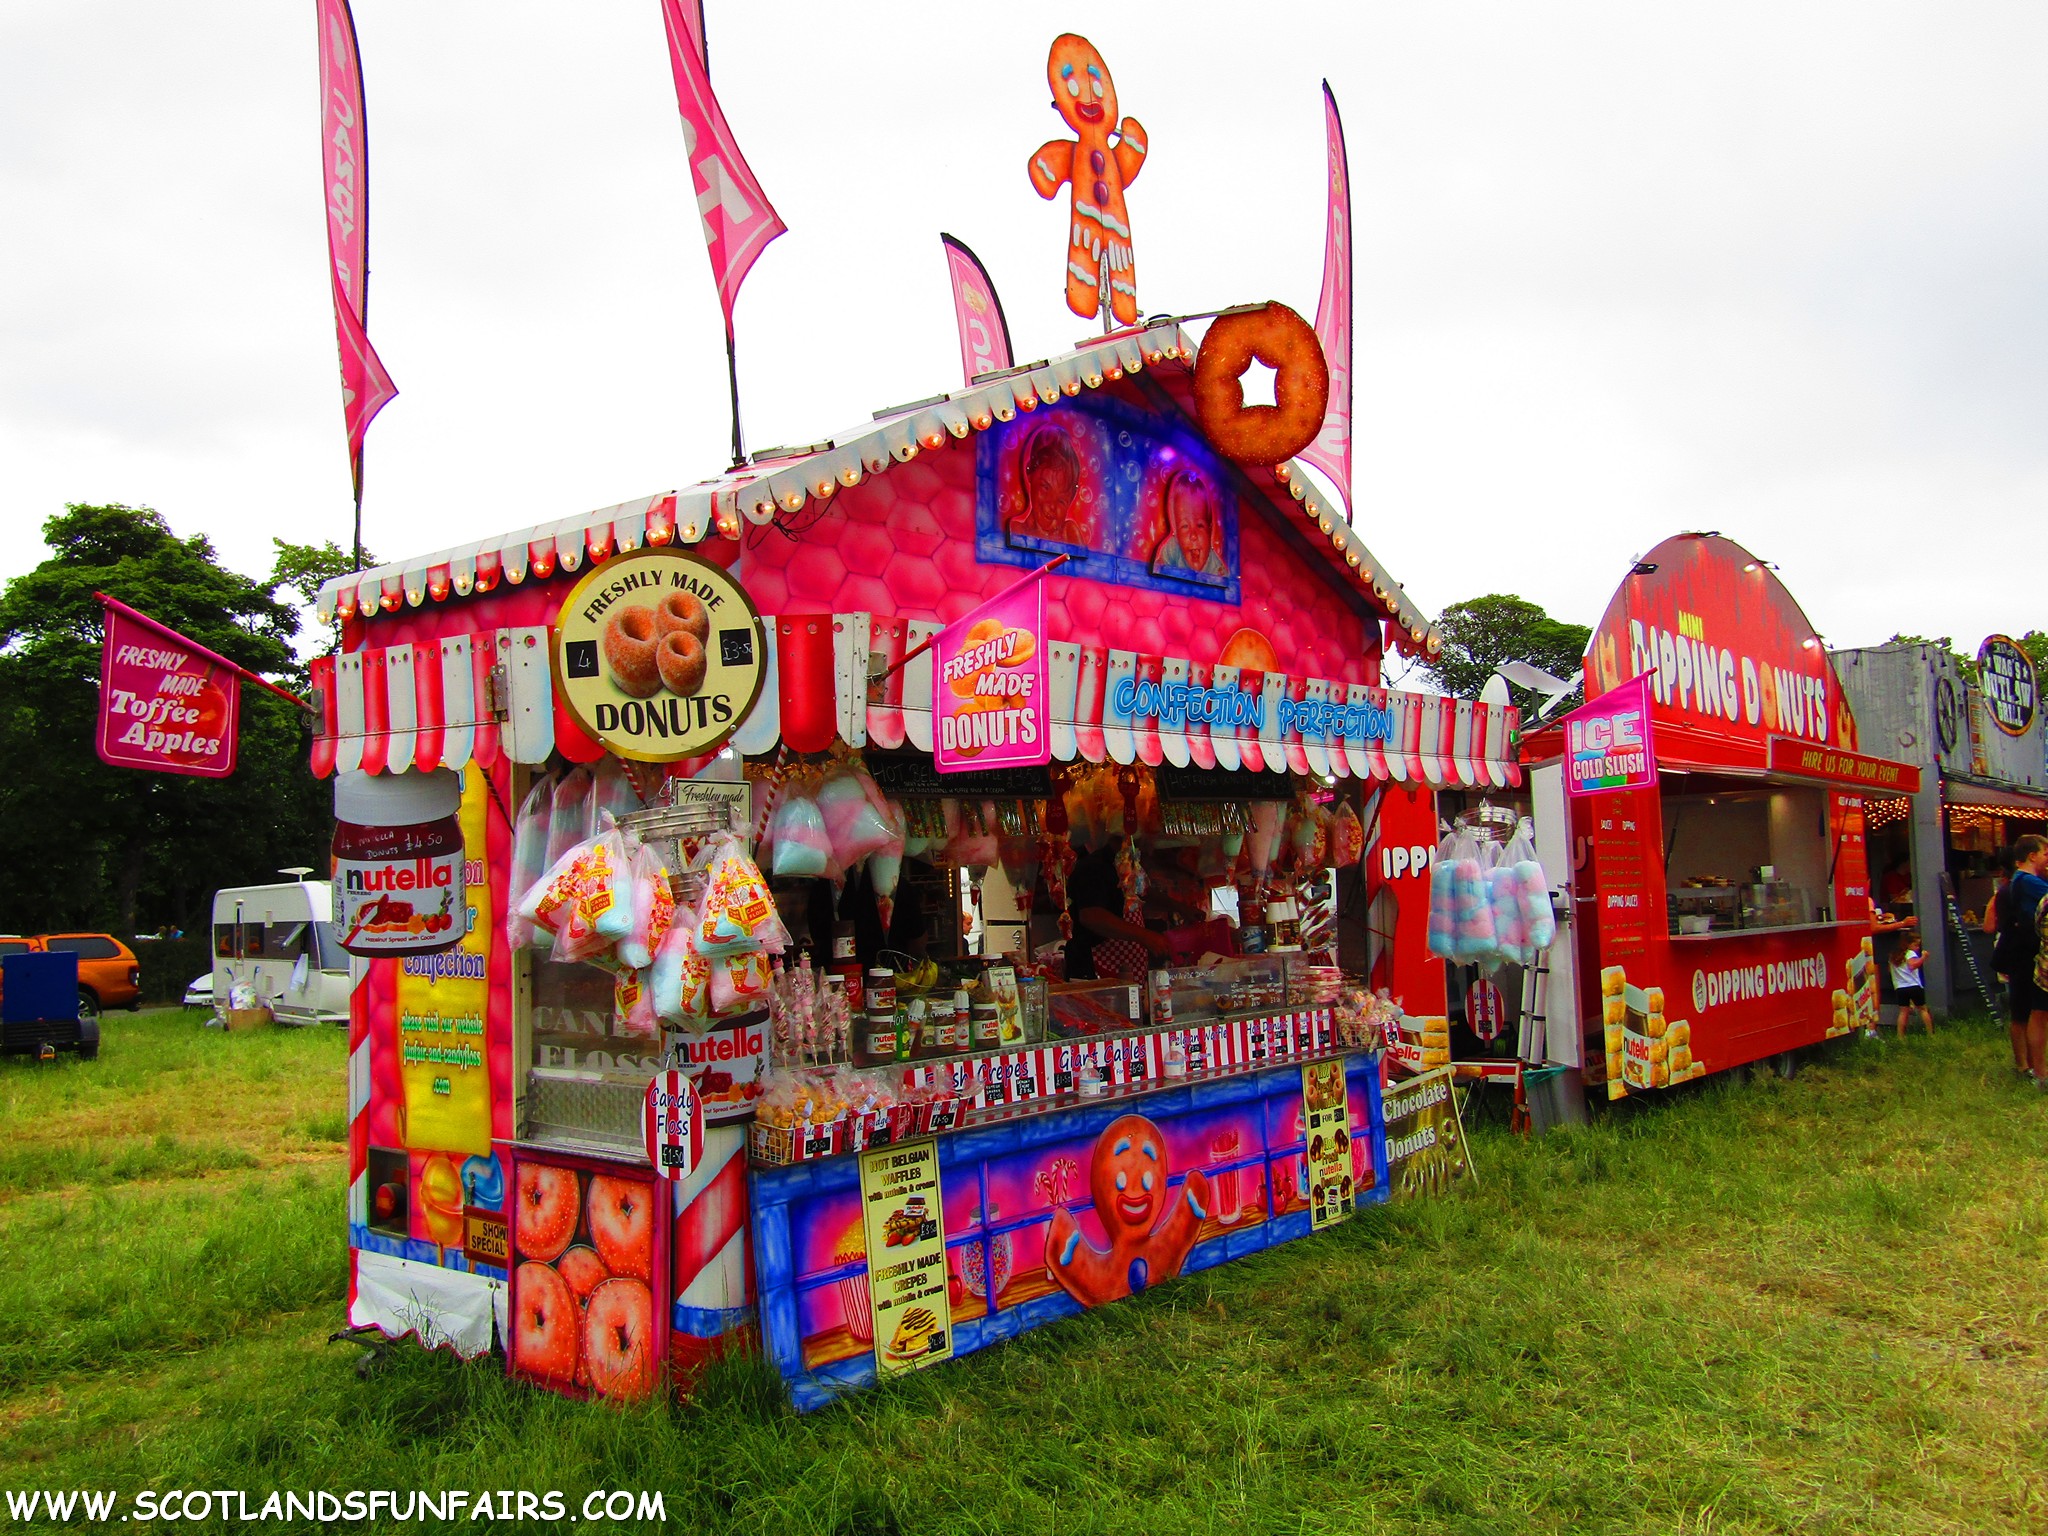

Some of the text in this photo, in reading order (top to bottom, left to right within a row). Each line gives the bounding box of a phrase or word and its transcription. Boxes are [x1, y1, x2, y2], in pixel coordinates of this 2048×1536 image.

[583, 569, 725, 624] FRESHLY MADE
[1678, 610, 1704, 641] MINI
[116, 644, 188, 671] FRESHLY
[578, 649, 591, 668] 4
[943, 632, 1018, 683] FRESHLY
[159, 674, 207, 696] MADE
[975, 673, 1035, 696] MADE
[1631, 619, 1828, 744] DIPPING DONUTS
[111, 689, 200, 725] Toffee
[595, 694, 733, 738] DONUTS
[1115, 679, 1394, 741] CONFECTION PERFECTION
[118, 722, 220, 755] Apples
[941, 708, 1037, 750] DONUTS
[1572, 711, 1643, 753] ICE
[1573, 753, 1645, 781] COLD SLUSH
[1801, 751, 1899, 783] HIRE US FOR YOUR EVENT
[722, 788, 745, 802] made
[347, 857, 452, 891] nutella
[1707, 965, 1765, 1006] DIPPING
[1767, 957, 1816, 994] DONUTS
[401, 1009, 483, 1035] please visit our website
[889, 1016, 904, 1027] HOT
[1204, 1026, 1228, 1040] Waffle
[675, 1027, 763, 1063] nutella
[1059, 1041, 1146, 1070] Giant Cables
[1396, 1047, 1421, 1061] ella
[1624, 1036, 1649, 1061] nutella
[434, 1078, 450, 1094] .com
[925, 1061, 1029, 1088] Fsh Crepes
[650, 1087, 695, 1118] Candy
[1382, 1082, 1448, 1124] Chocolate
[657, 1112, 688, 1136] Floss
[1322, 1113, 1332, 1123] FOR
[1385, 1126, 1437, 1164] Donuts
[870, 1149, 930, 1173] HOT BELGIAN
[1319, 1163, 1343, 1177] nutella
[881, 1167, 922, 1187] WAFFLES
[868, 1191, 883, 1202] with
[884, 1185, 907, 1199] nutella
[1328, 1205, 1339, 1216] FOR
[471, 1234, 506, 1256] SPECIAL
[875, 1252, 942, 1283] FRESHLY MADE
[893, 1273, 928, 1293] CREPES
[877, 1299, 892, 1311] with
